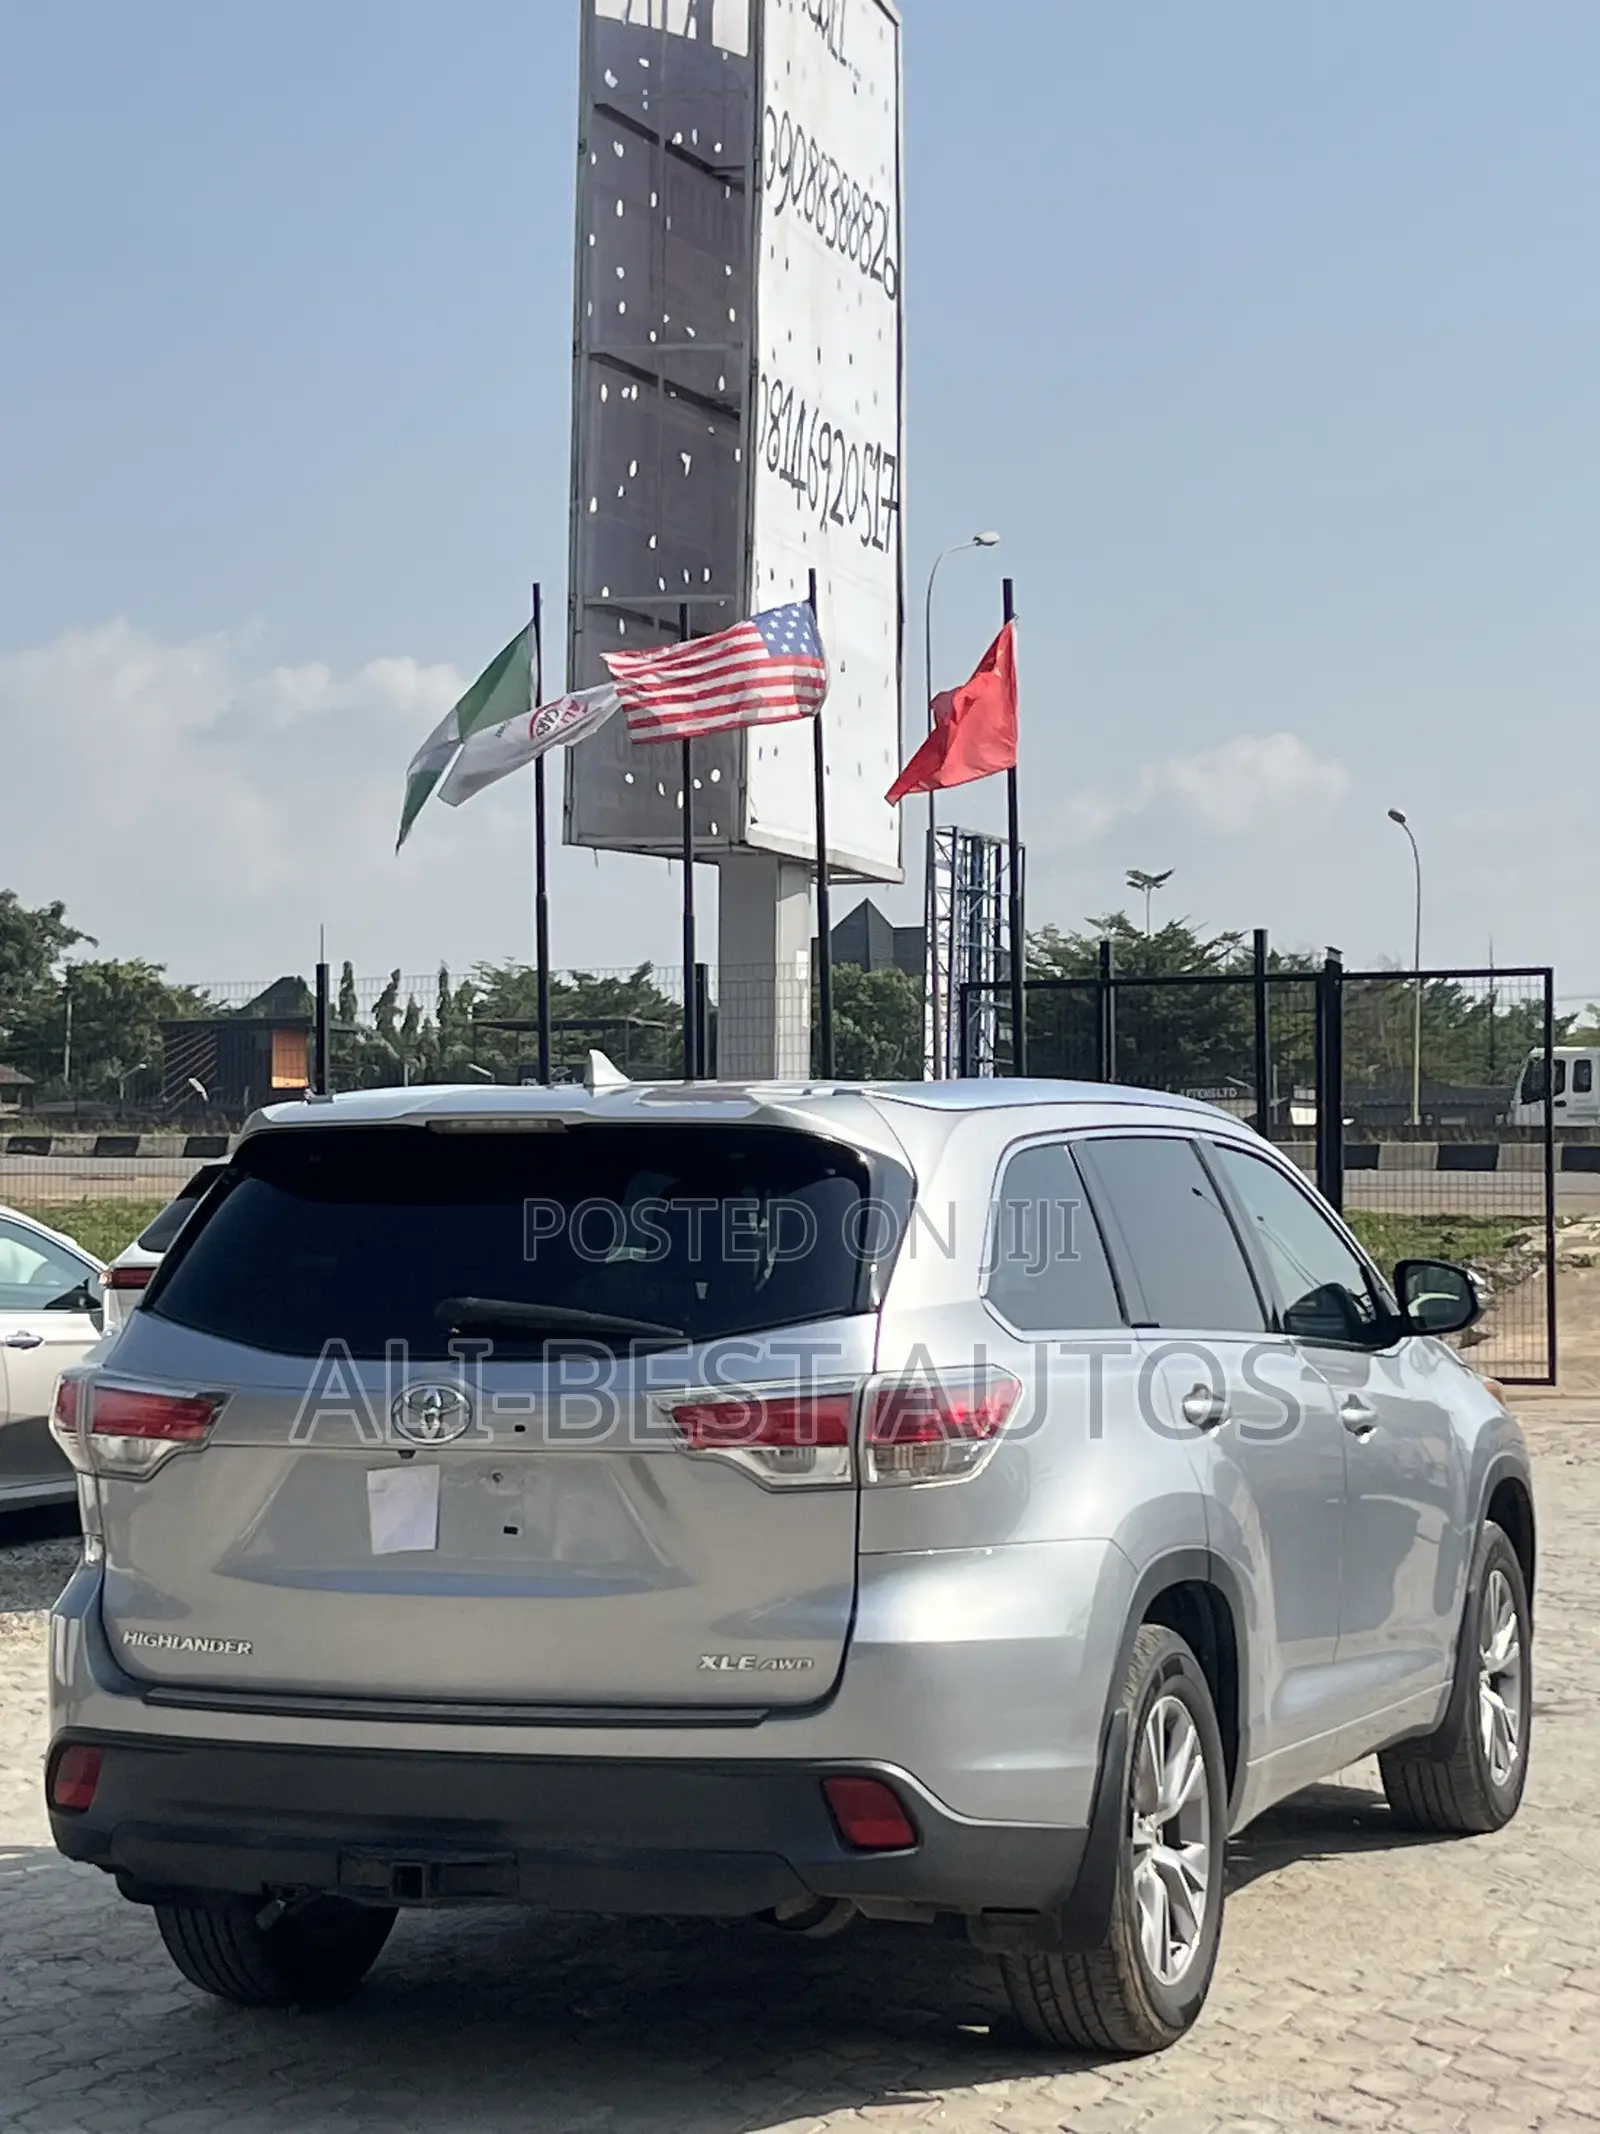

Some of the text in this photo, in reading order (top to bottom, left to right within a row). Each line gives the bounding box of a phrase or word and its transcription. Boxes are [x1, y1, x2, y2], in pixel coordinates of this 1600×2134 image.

[122, 1630, 253, 1656] HIGHLANDER
[699, 1655, 815, 1671] XLE AWD
